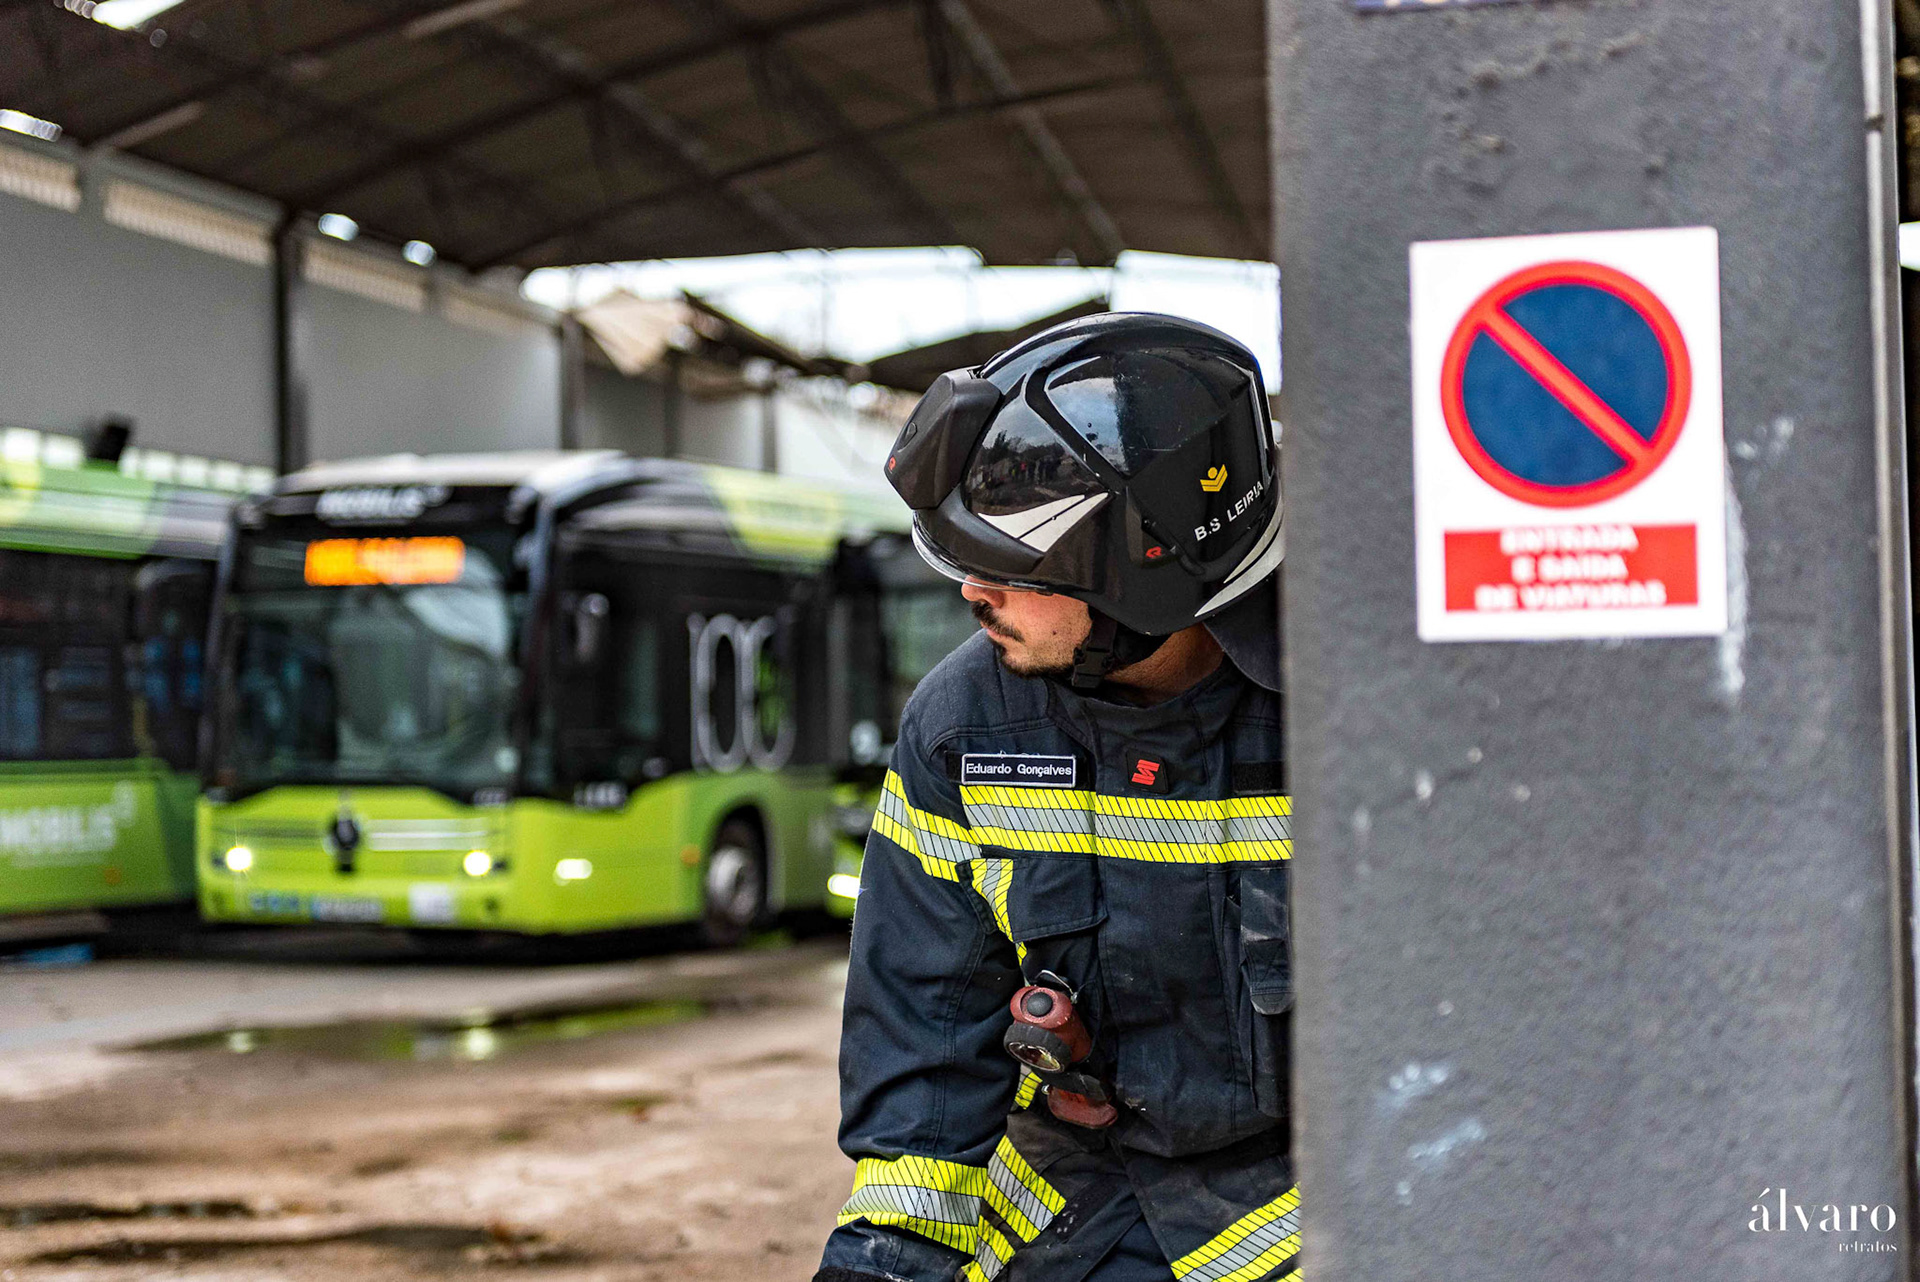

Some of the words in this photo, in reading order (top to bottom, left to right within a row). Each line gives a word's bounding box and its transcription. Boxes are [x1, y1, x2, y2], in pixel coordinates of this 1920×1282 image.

[1194, 518, 1221, 541] B.S
[1226, 481, 1264, 522] LEIRIA
[1500, 526, 1639, 556] ENTRADA
[1511, 554, 1536, 584] E
[1474, 583, 1517, 610] DE
[966, 763, 1012, 775] Eduardo
[1017, 763, 1072, 778] Gonçalves
